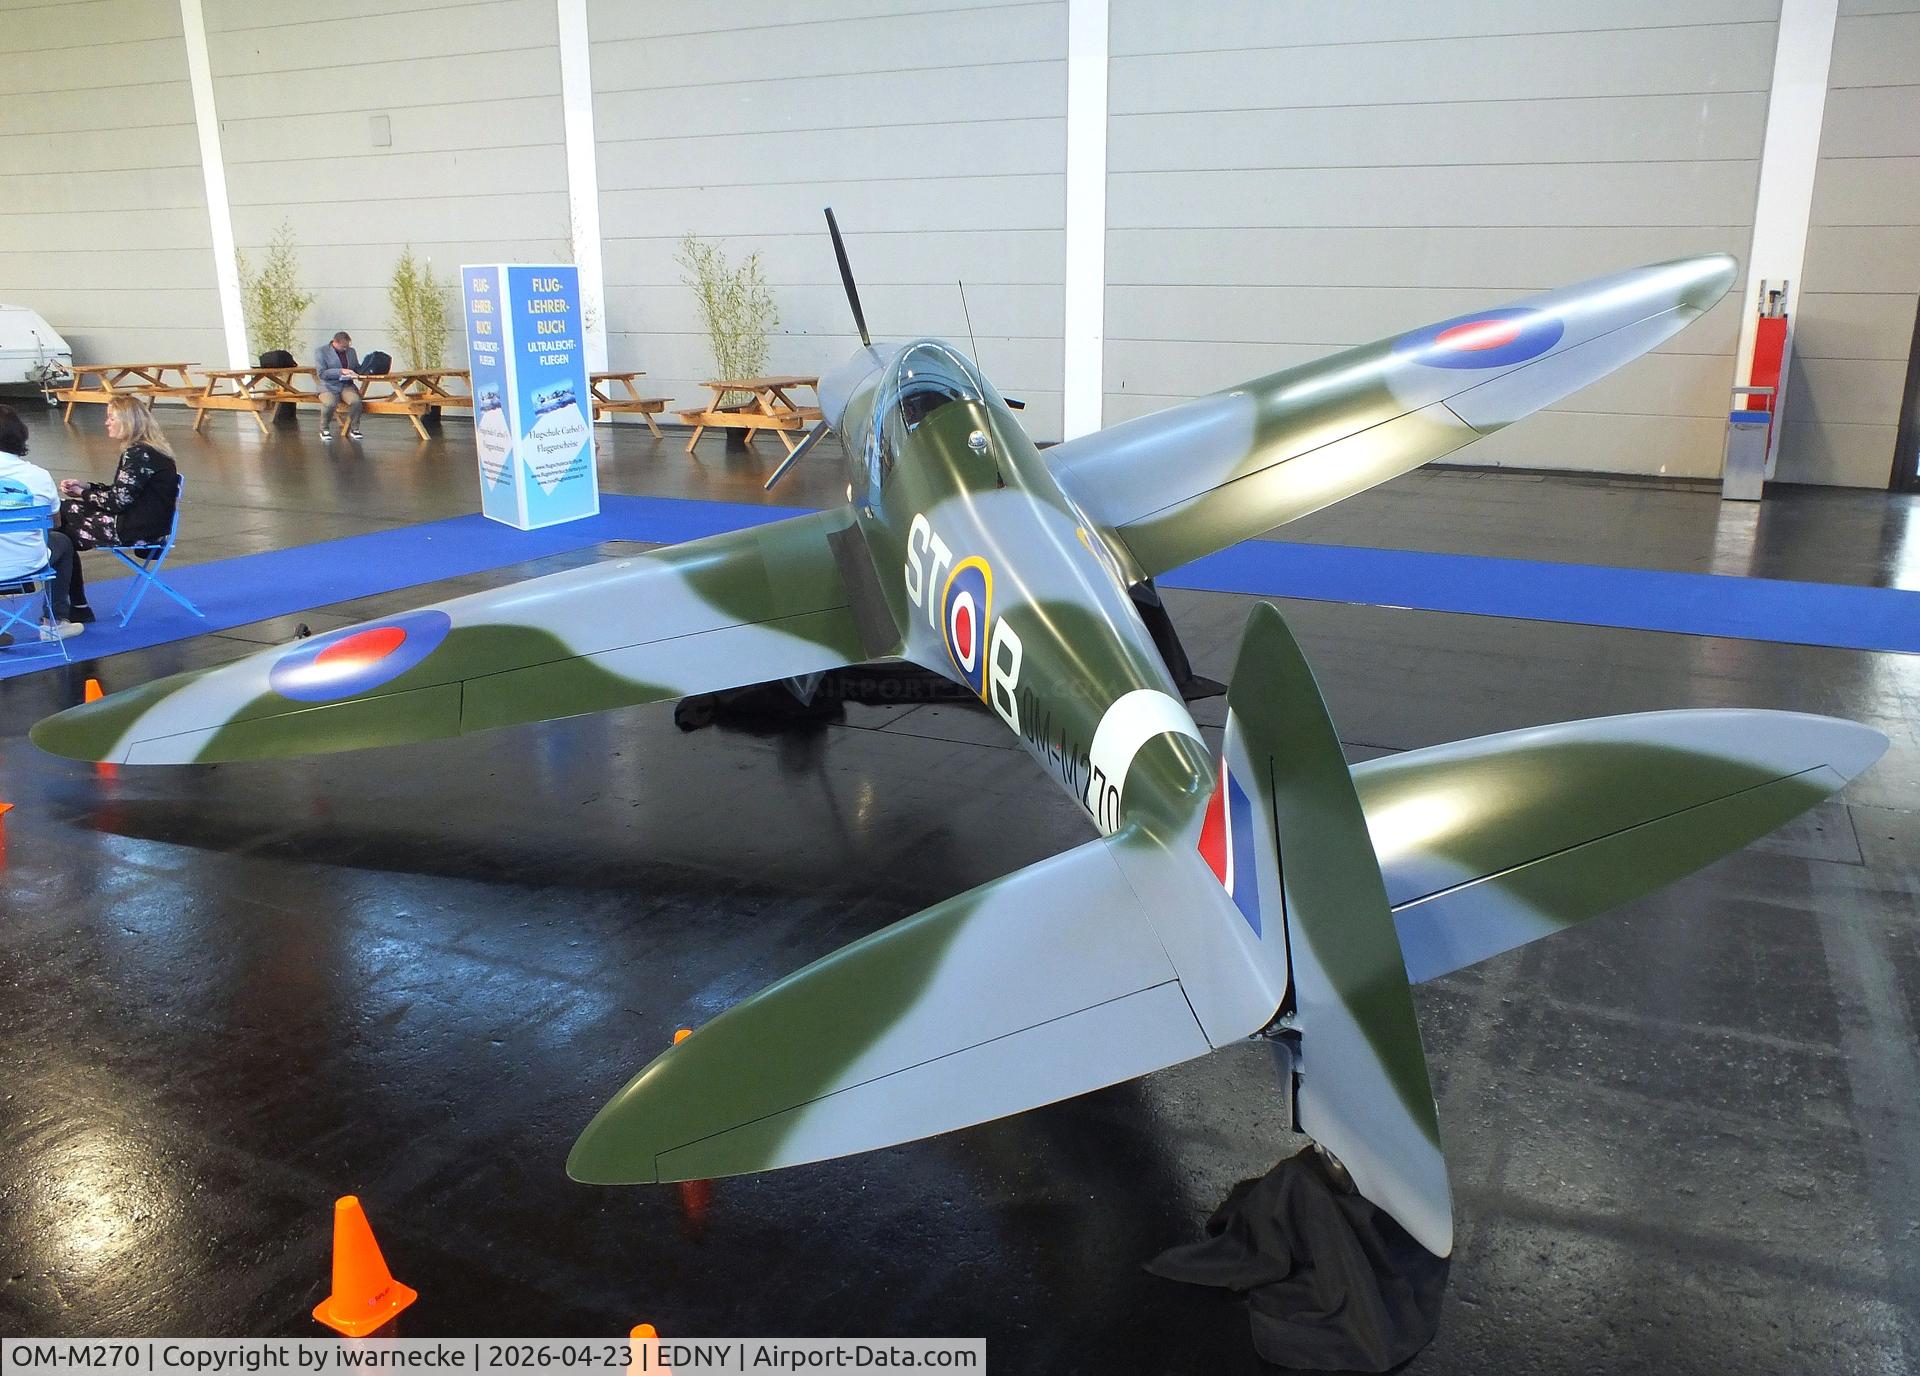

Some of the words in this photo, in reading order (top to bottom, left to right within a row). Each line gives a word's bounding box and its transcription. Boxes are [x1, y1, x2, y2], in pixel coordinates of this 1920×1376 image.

[532, 278, 564, 292] FLUG-
[528, 299, 570, 314] LEHRER-
[537, 320, 566, 335] BUCH
[527, 340, 577, 352] ULTRALEICHT-
[540, 354, 569, 366] FLIEGEN
[904, 512, 953, 630] ST
[989, 615, 1024, 737] B
[1023, 687, 1120, 835] OM-M270
